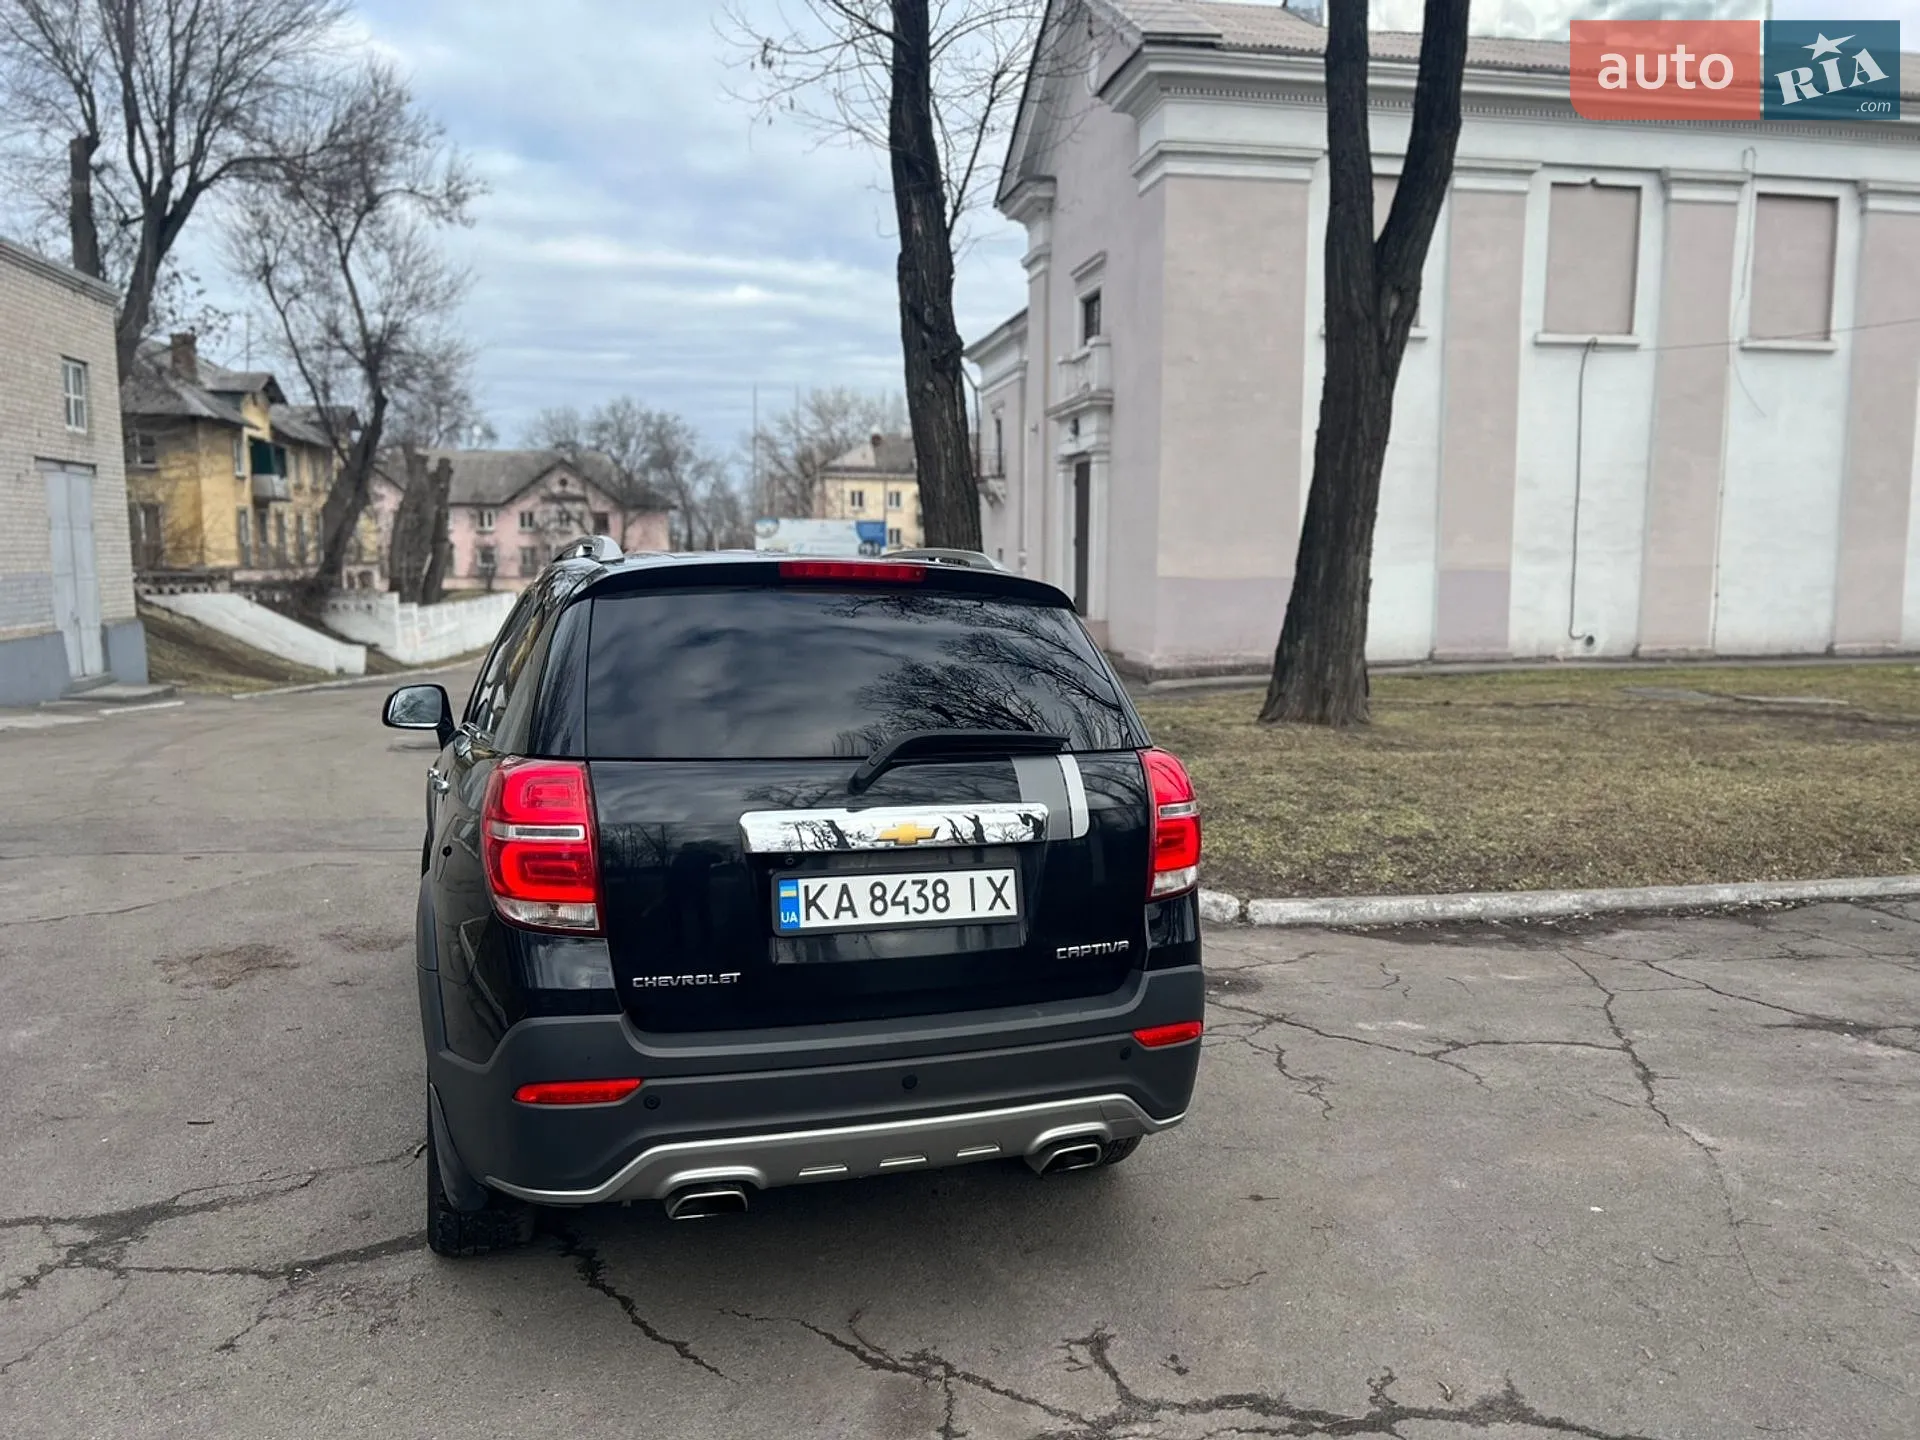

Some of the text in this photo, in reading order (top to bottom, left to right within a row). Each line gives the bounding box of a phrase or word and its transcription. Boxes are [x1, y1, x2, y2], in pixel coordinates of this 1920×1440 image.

[803, 875, 1012, 921] KA 8438 IX
[781, 911, 798, 923] UA
[1056, 940, 1129, 959] CAPTIVA
[632, 972, 741, 988] CHEVROLET
